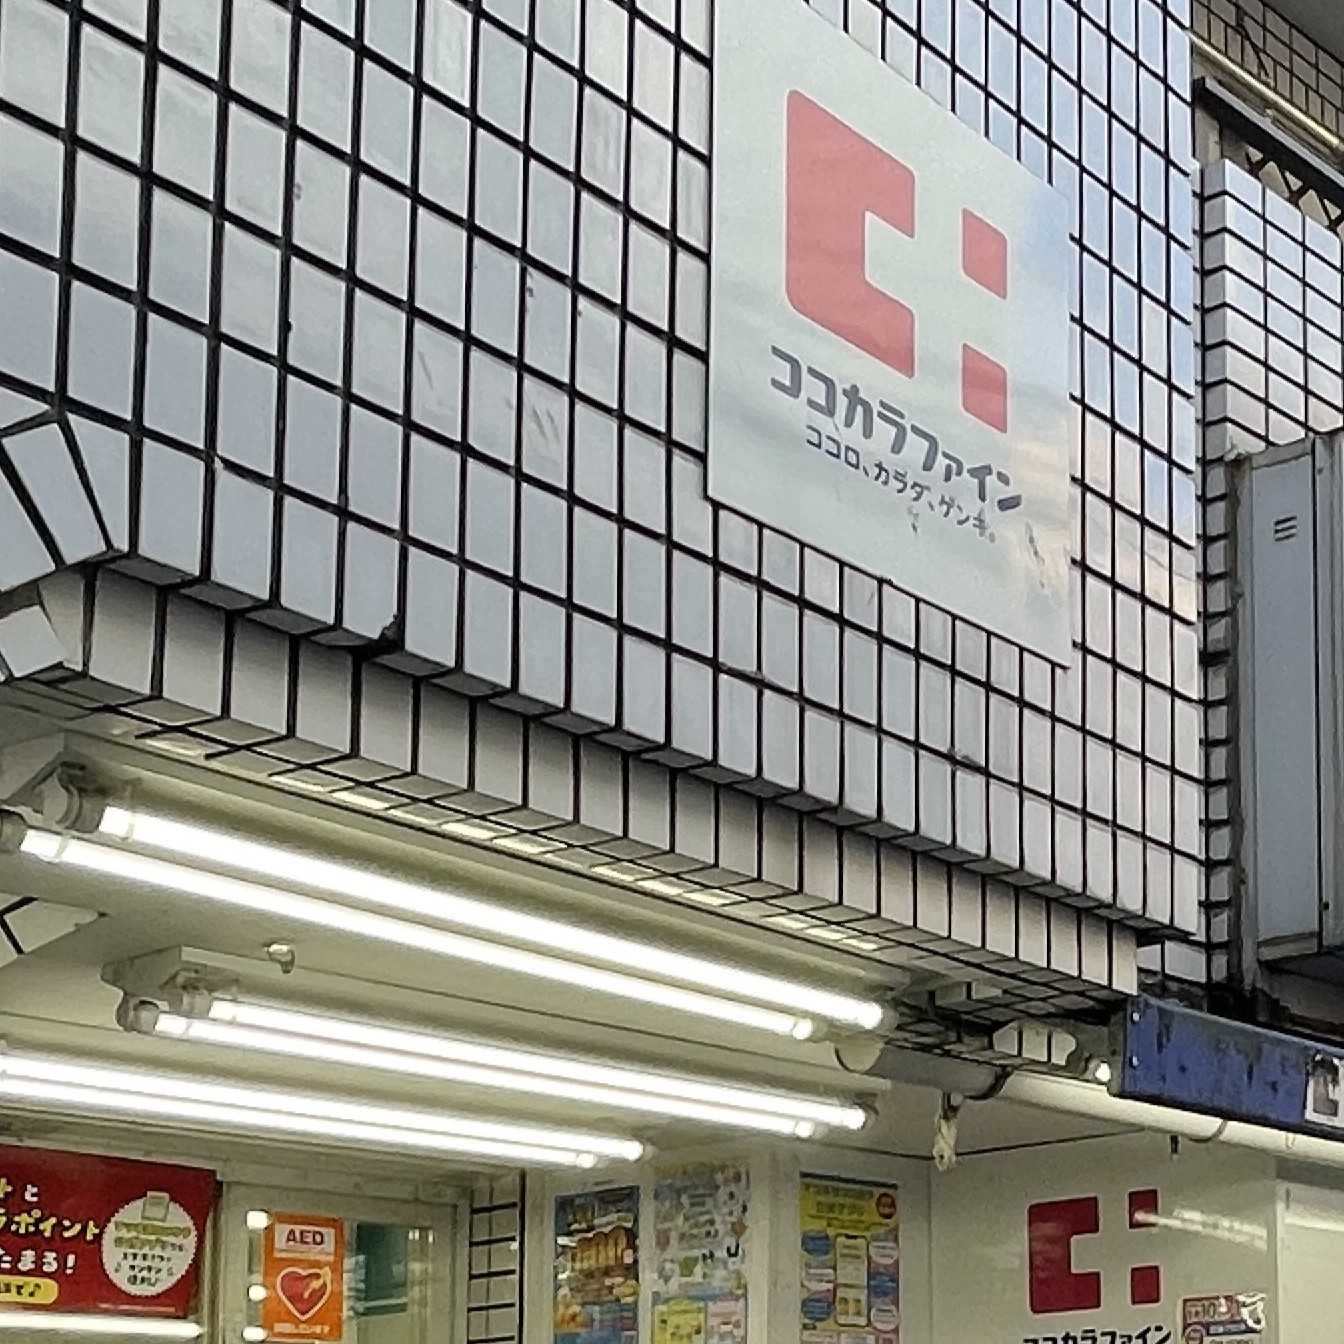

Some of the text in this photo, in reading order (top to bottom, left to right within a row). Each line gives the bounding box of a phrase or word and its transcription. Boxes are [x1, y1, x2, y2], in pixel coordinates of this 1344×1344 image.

[770, 345, 1022, 512] ココカラファイン
[285, 1228, 325, 1247] AED
